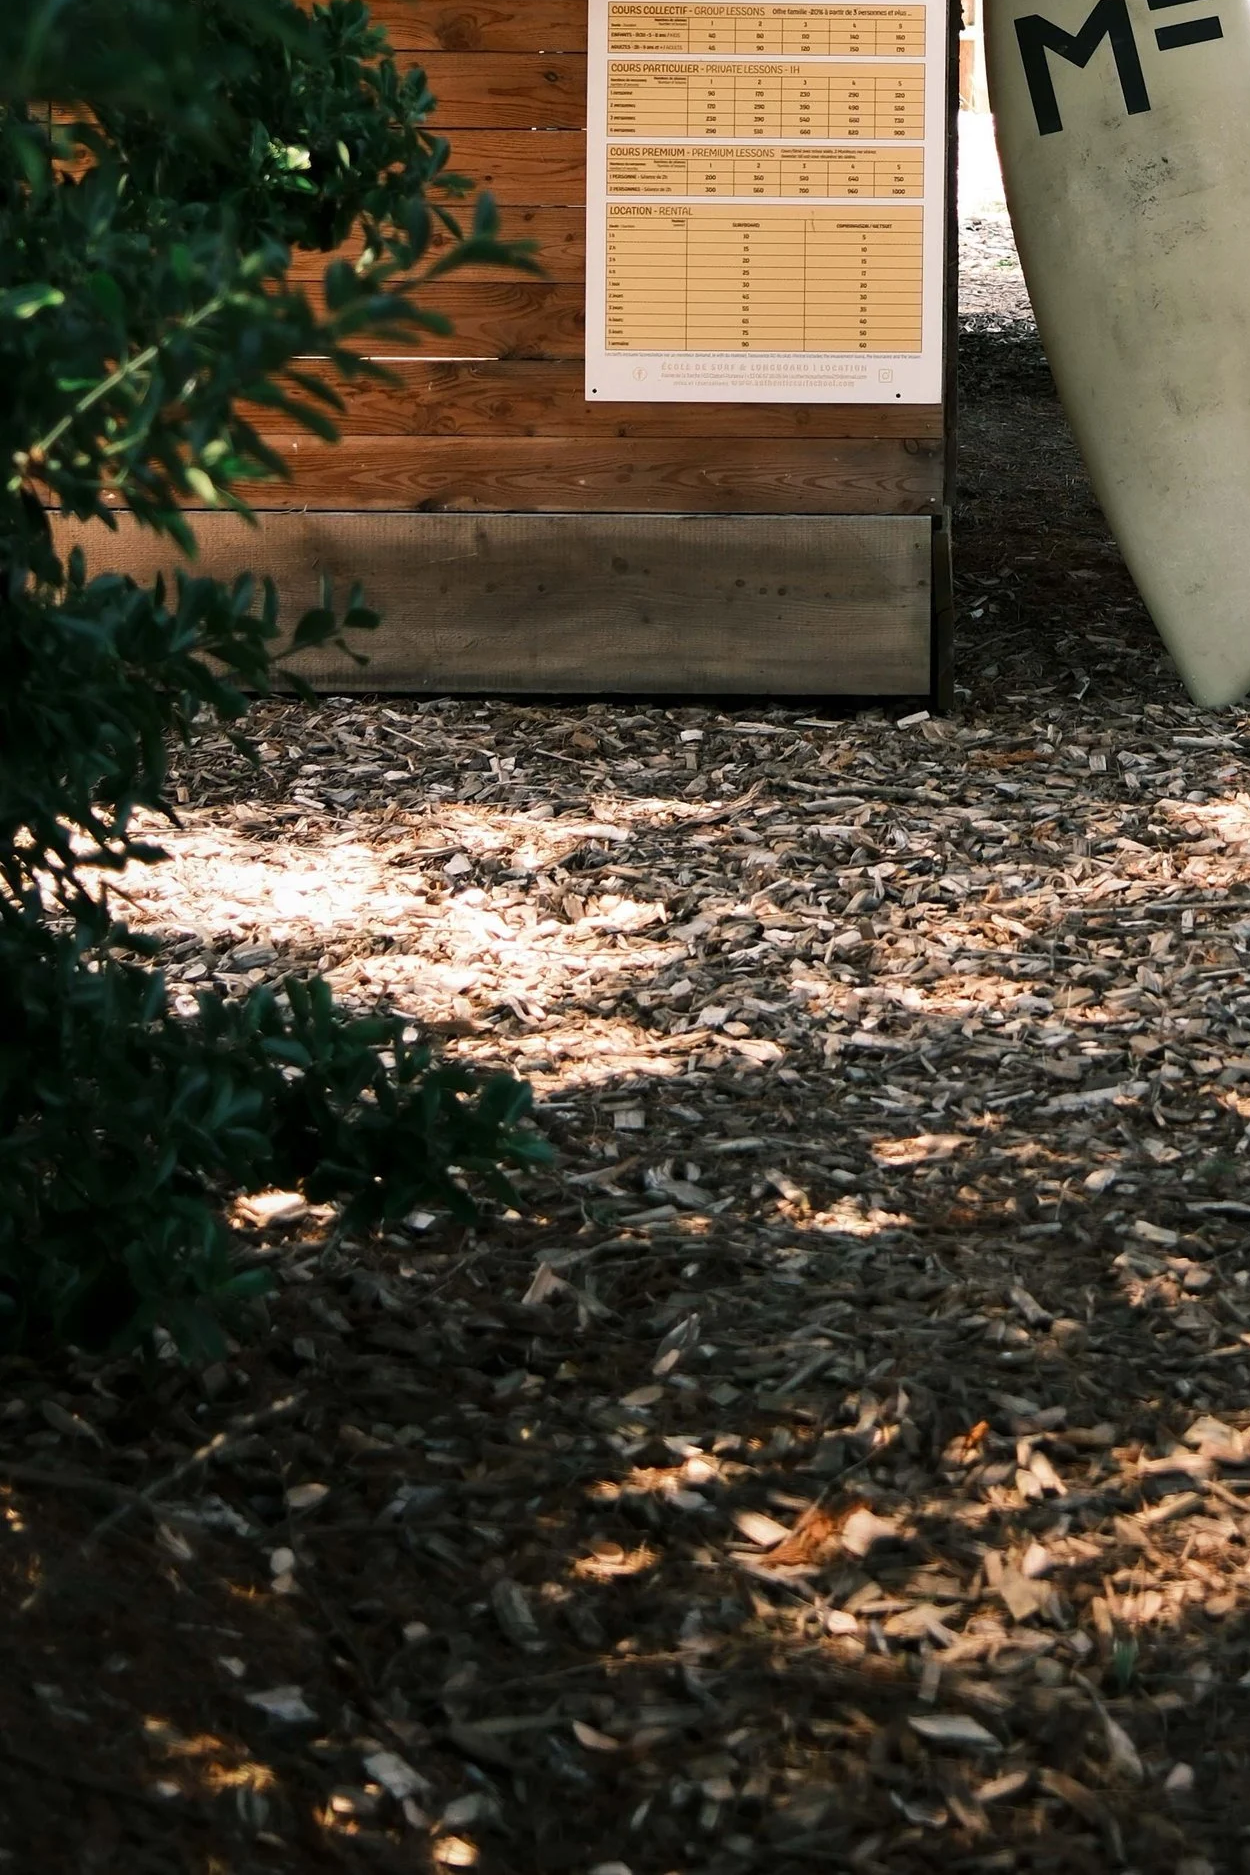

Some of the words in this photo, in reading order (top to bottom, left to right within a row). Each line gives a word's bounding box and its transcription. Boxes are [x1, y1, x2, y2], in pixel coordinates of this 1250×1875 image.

[611, 5, 642, 15] COURS
[643, 5, 688, 15] COLLECTIF
[694, 6, 725, 16] GROUP
[726, 6, 765, 16] LESSONS
[858, 9, 887, 17] personnes
[611, 63, 641, 73] COURS
[643, 63, 699, 73] PARTICULIER
[706, 64, 743, 74] PRIVATE
[743, 65, 783, 74] LESSONS
[610, 147, 641, 157] COURS
[642, 147, 685, 157] PREMIUM
[692, 148, 734, 158] PREMIUM
[735, 148, 775, 158] LESSONS
[609, 206, 652, 215] LOCATION
[659, 206, 694, 216] RENTAL
